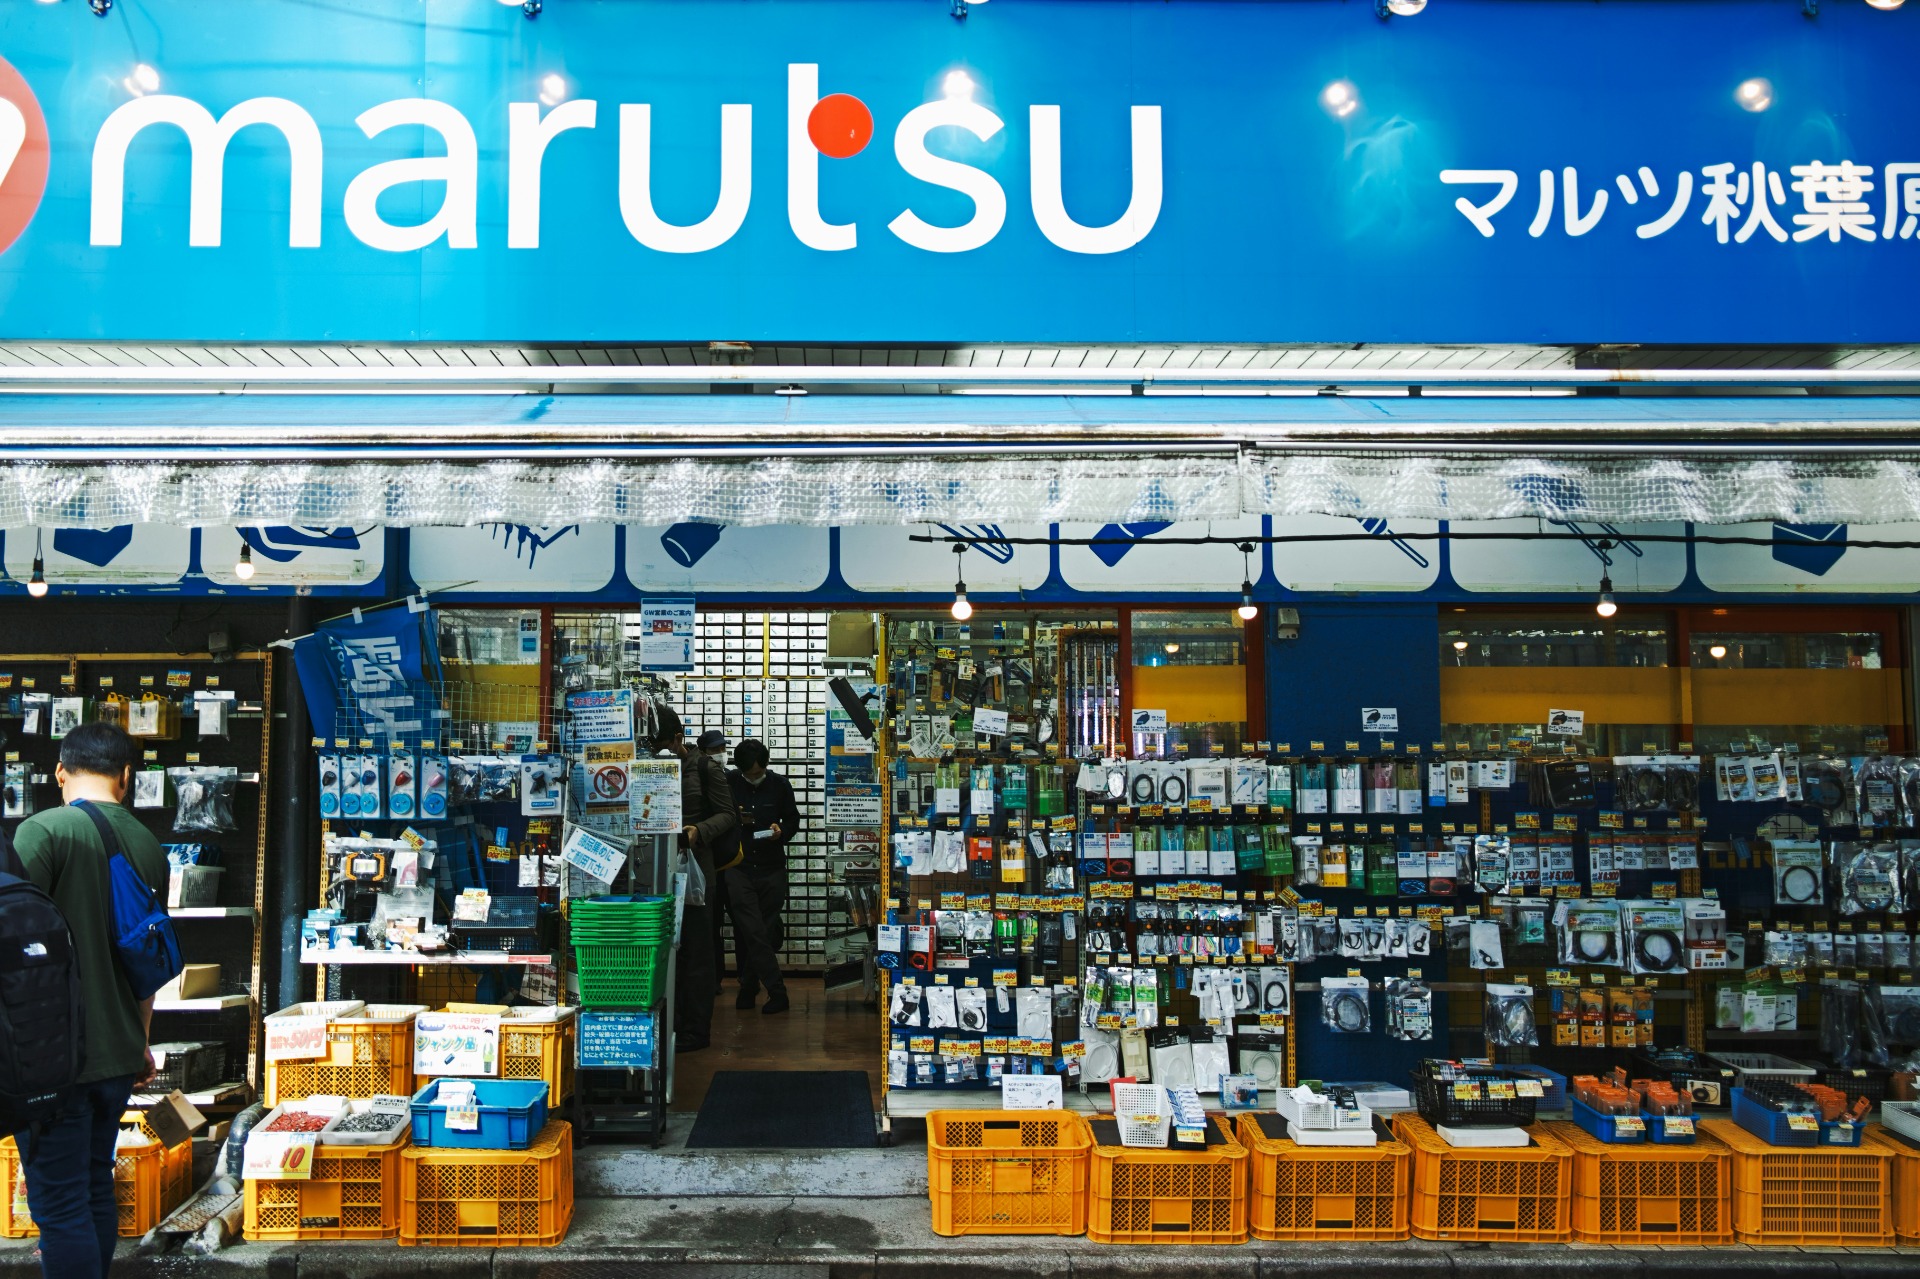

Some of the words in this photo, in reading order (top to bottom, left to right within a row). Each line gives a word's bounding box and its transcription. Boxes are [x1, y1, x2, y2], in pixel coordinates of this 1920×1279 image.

[90, 63, 1163, 254] marutsu
[644, 609, 692, 617] GW営業のご案内
[416, 1036, 478, 1052] ジャンク品
[279, 1147, 305, 1169] 10
